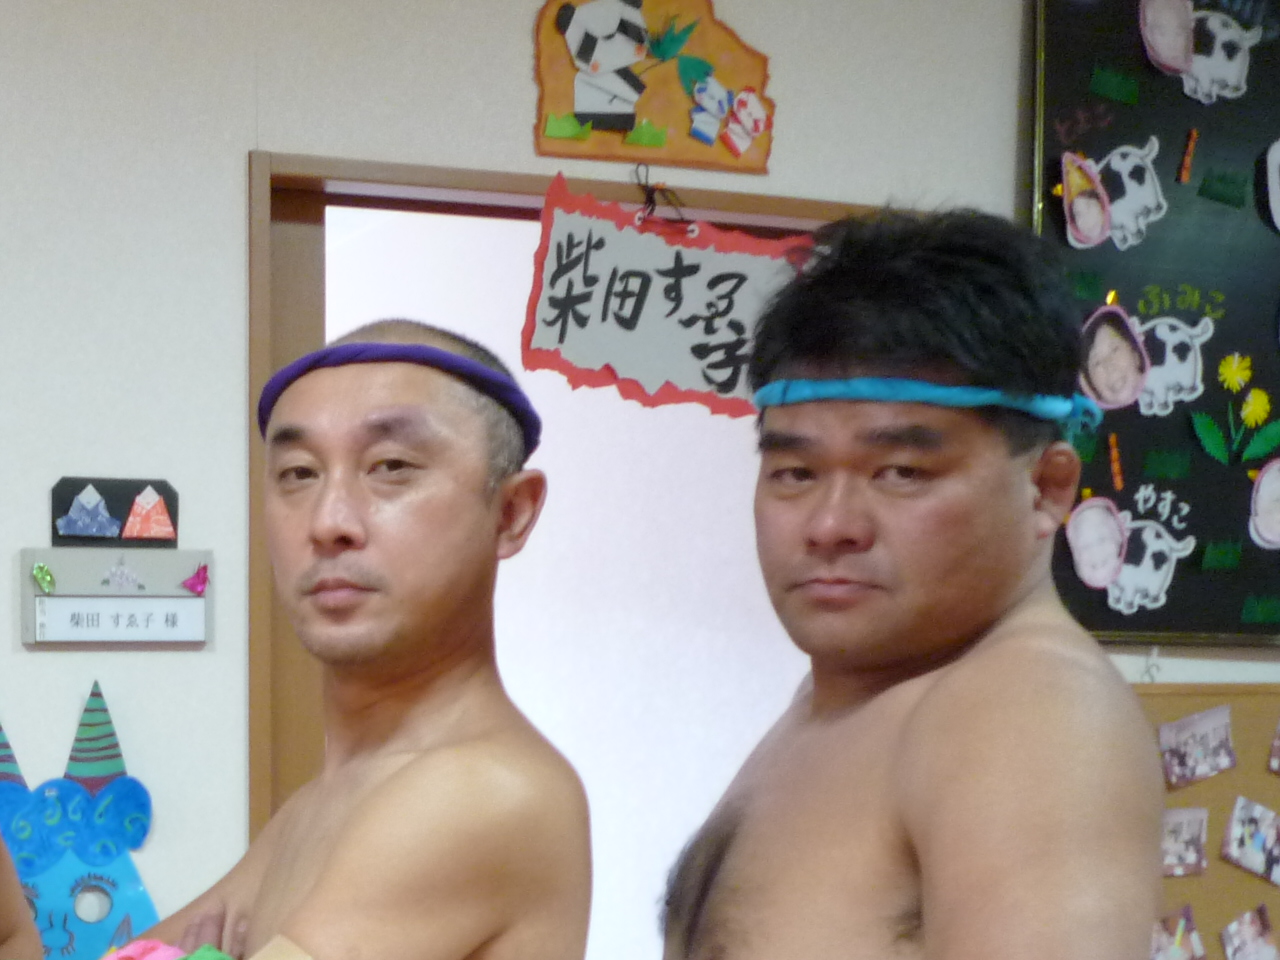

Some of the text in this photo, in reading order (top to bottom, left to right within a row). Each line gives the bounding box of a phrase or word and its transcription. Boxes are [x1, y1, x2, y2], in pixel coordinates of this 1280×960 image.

[1133, 483, 1191, 530] やすこ
[70, 612, 100, 628] 柴田
[164, 612, 178, 628] 様
